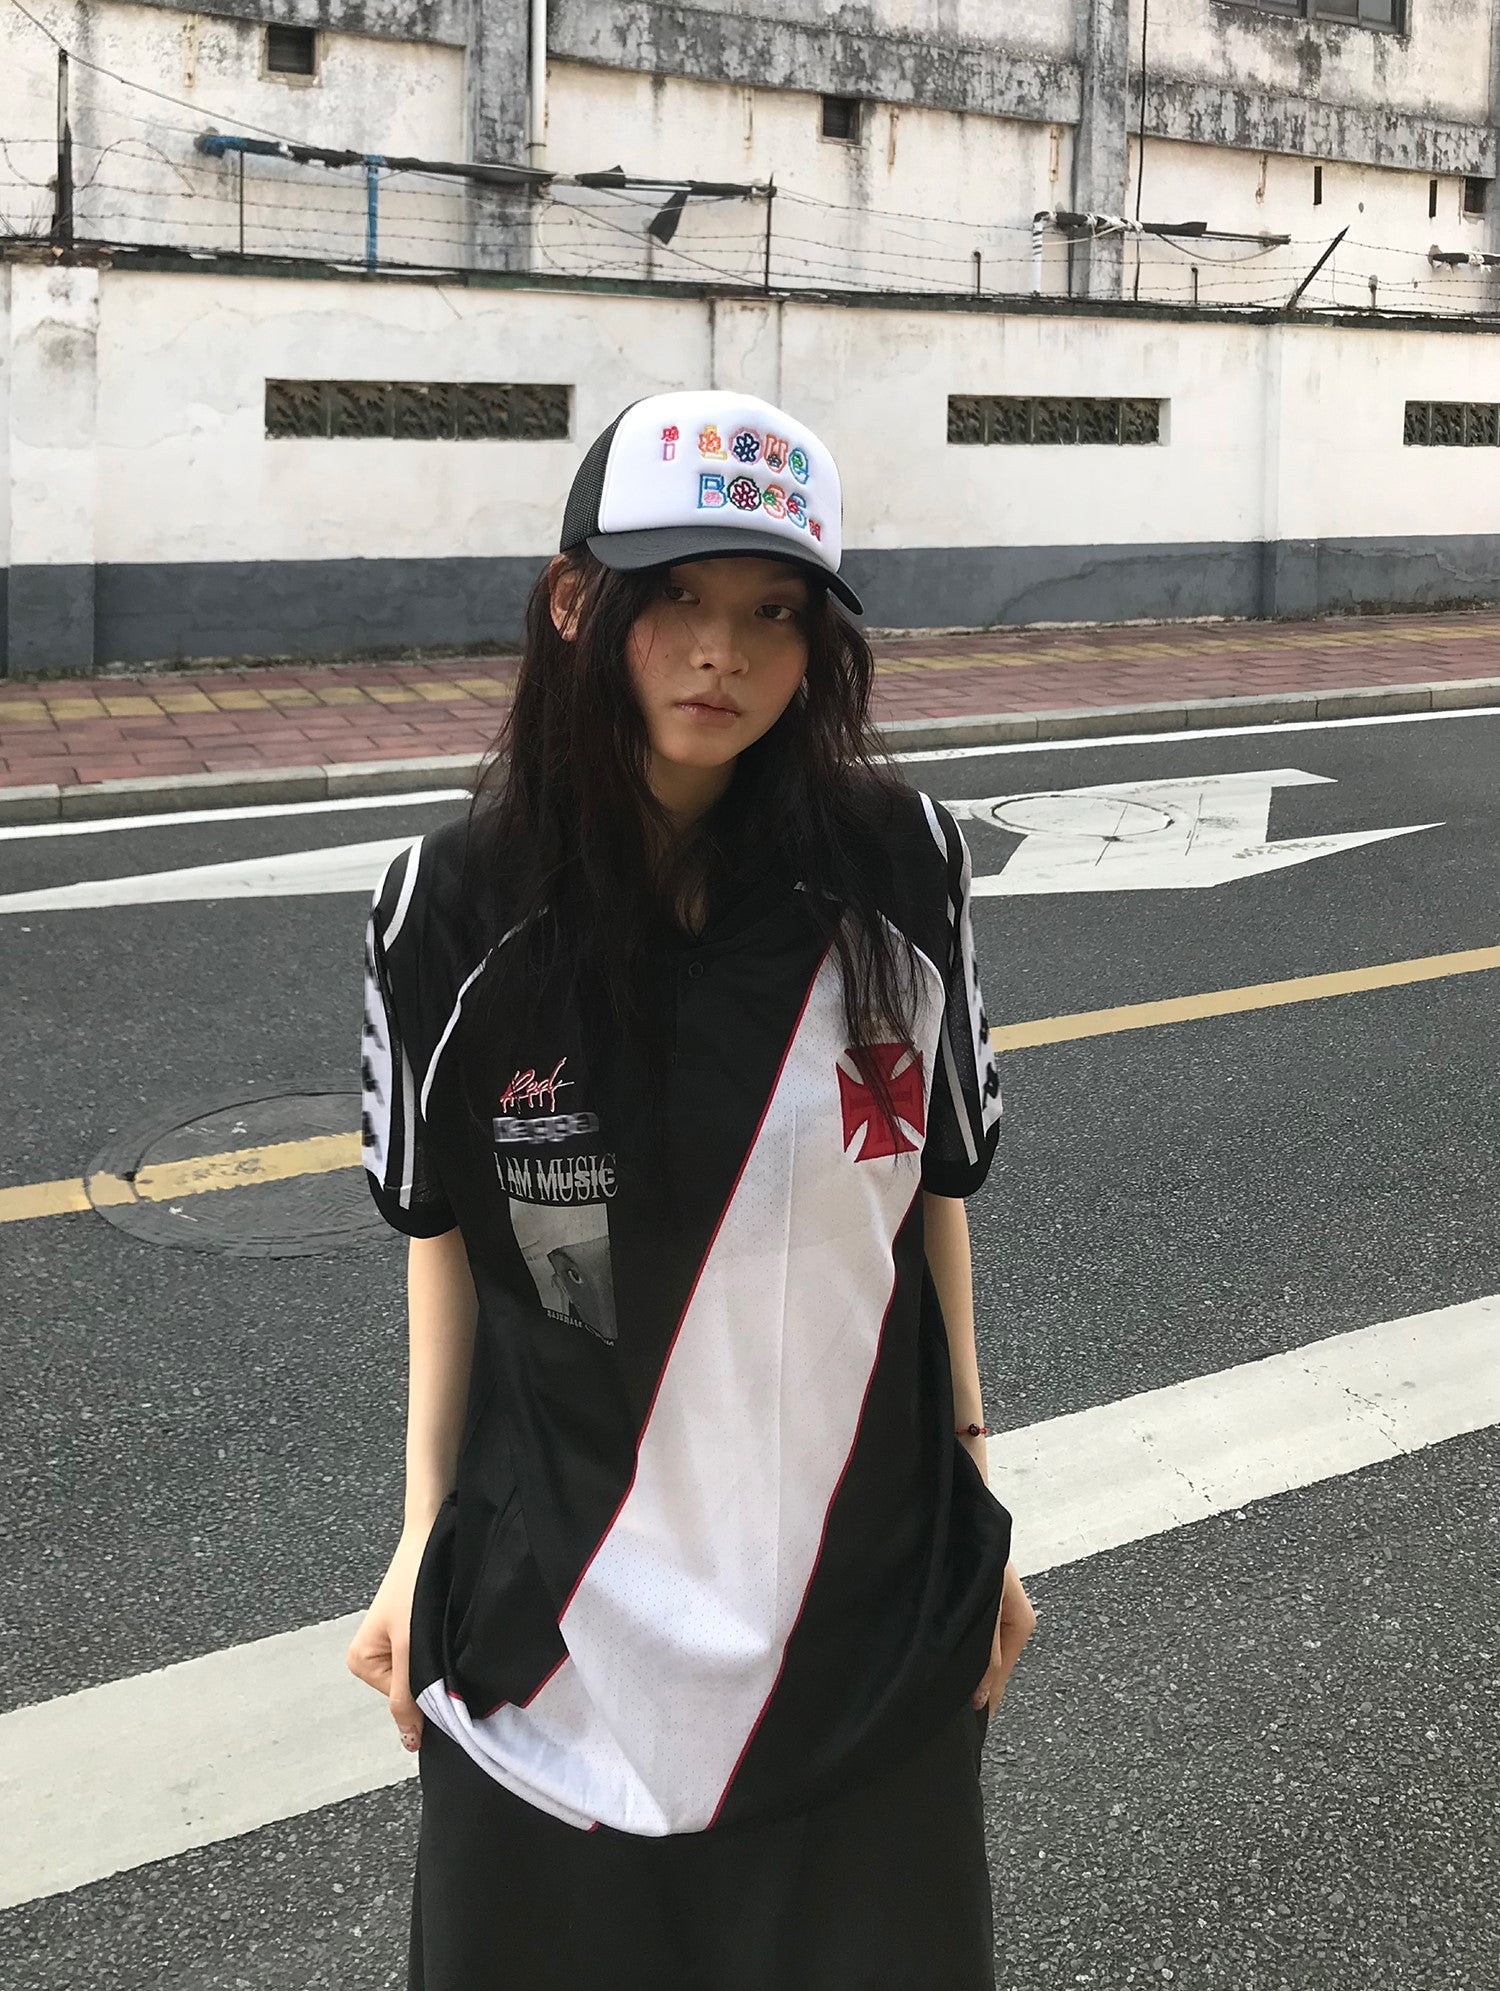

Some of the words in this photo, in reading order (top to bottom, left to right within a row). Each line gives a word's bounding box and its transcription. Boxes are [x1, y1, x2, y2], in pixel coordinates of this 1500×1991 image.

[697, 473, 807, 528] BOSS
[493, 1151, 506, 1190] I
[505, 1156, 534, 1199] AM
[536, 1153, 618, 1202] MUSIC
